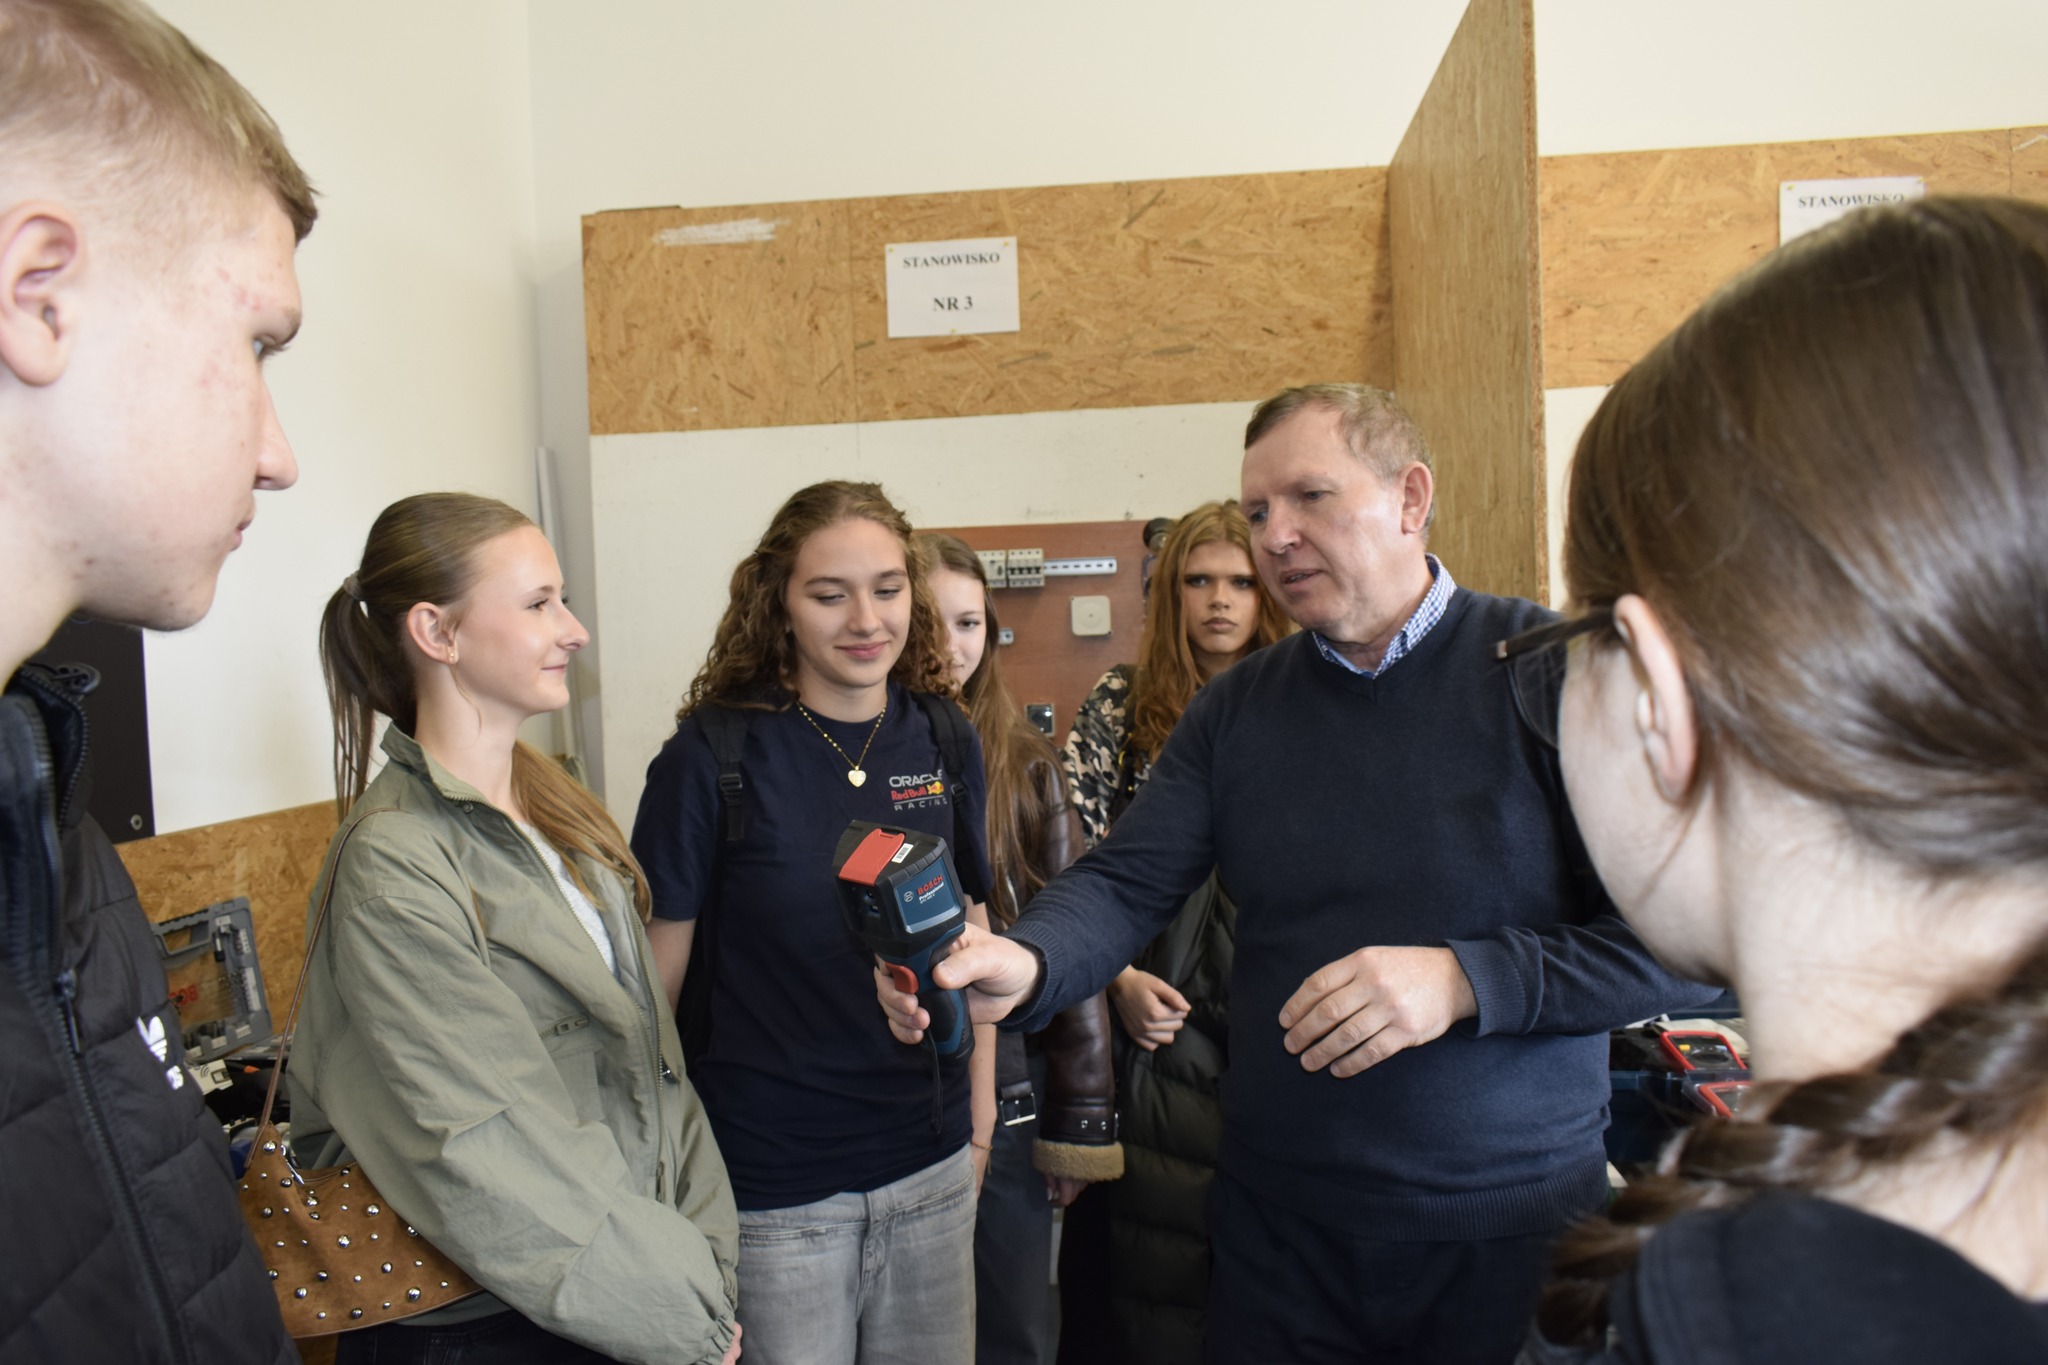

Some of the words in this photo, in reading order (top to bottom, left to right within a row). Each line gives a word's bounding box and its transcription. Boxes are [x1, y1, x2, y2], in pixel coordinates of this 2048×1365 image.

[903, 252, 1000, 268] STANOWISKO
[933, 297, 959, 311] NR
[964, 296, 973, 310] 3
[889, 769, 942, 787] ORACLE
[917, 875, 943, 895] BOSCH
